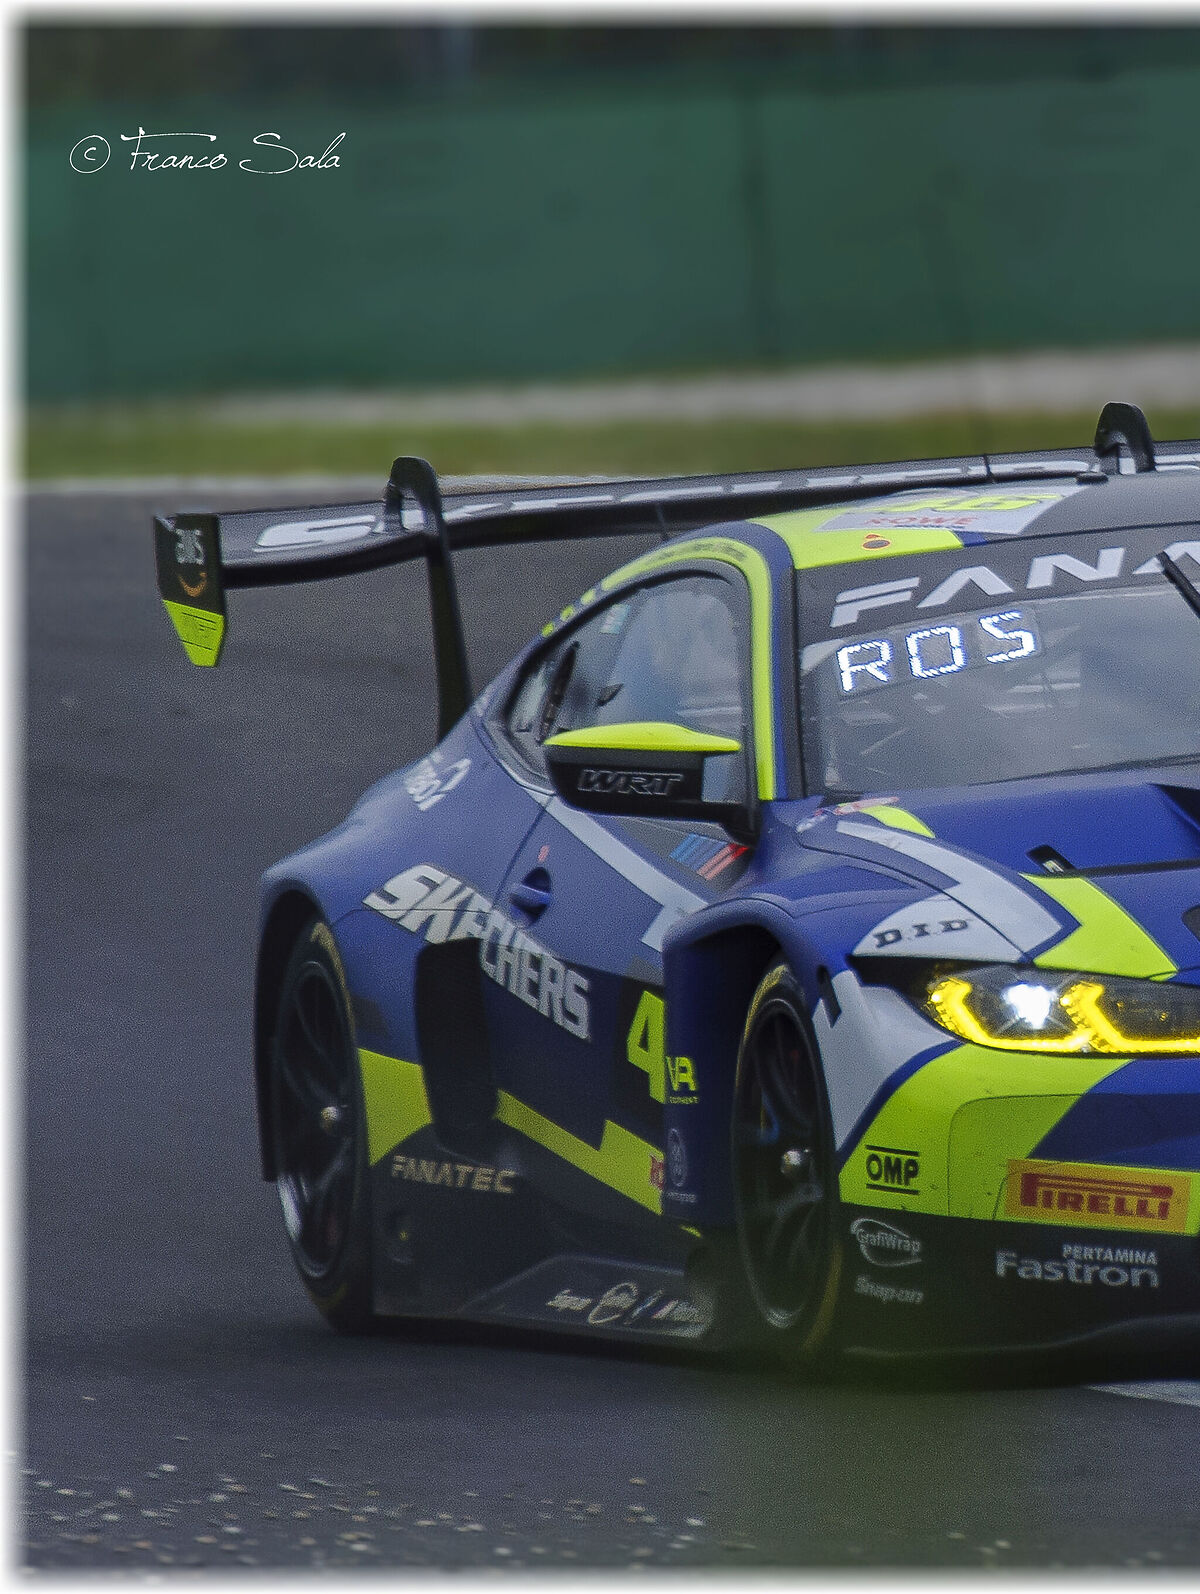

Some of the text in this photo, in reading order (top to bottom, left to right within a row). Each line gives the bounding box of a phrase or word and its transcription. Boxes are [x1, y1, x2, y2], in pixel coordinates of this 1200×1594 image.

[836, 610, 1038, 693] ROS
[577, 769, 684, 796] WRT
[392, 1155, 517, 1194] FANATEC
[866, 1153, 919, 1186] OMP
[1020, 1173, 1174, 1220] PIRELLI
[996, 1250, 1160, 1289] Fastron
[1062, 1244, 1158, 1266] PERTAMINA
